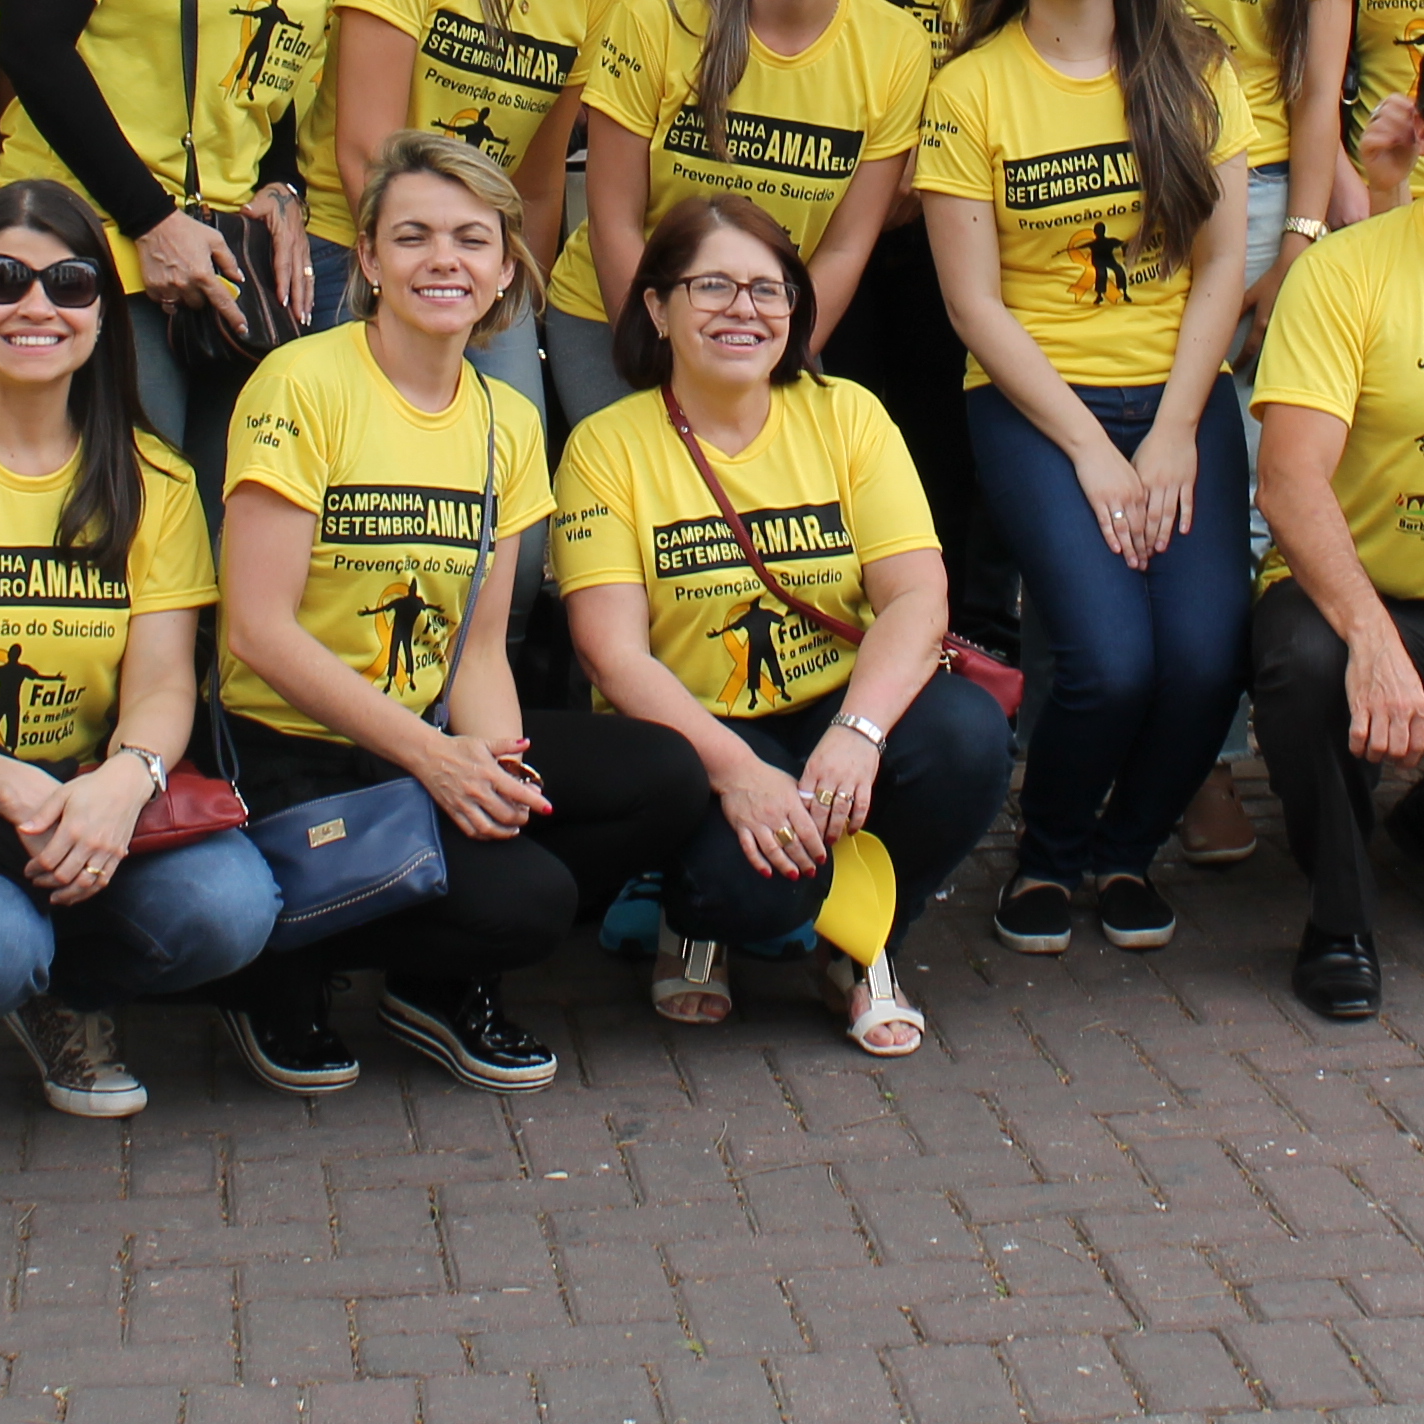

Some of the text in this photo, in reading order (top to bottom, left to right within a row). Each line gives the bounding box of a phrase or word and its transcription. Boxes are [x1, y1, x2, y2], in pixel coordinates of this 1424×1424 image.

[275, 28, 312, 59] Falar
[617, 51, 642, 74] pela
[425, 68, 512, 107] Prevenção do
[764, 129, 855, 173] AMARELO
[1006, 153, 1099, 183] CAMPANHA
[673, 162, 835, 203] Prevenção do Suicídio
[1007, 173, 1101, 203] SETEMBRO
[1018, 203, 1127, 231] Prevenção do
[327, 493, 425, 512] CAMPANHA
[580, 504, 608, 521] pela
[325, 516, 425, 536] SETEMBRO
[565, 527, 592, 543] Vida
[751, 514, 850, 554] AMARELO
[334, 554, 440, 574] Prevenção do
[675, 569, 842, 601] Prevenção Suicídio
[26, 619, 47, 636] do
[52, 619, 115, 638] Suicídio
[799, 634, 835, 655] melhor
[785, 648, 840, 683] SOLUÇÃO
[29, 683, 86, 707] Falar
[22, 710, 30, 724] é
[20, 721, 74, 746] SOLUÇÃO
